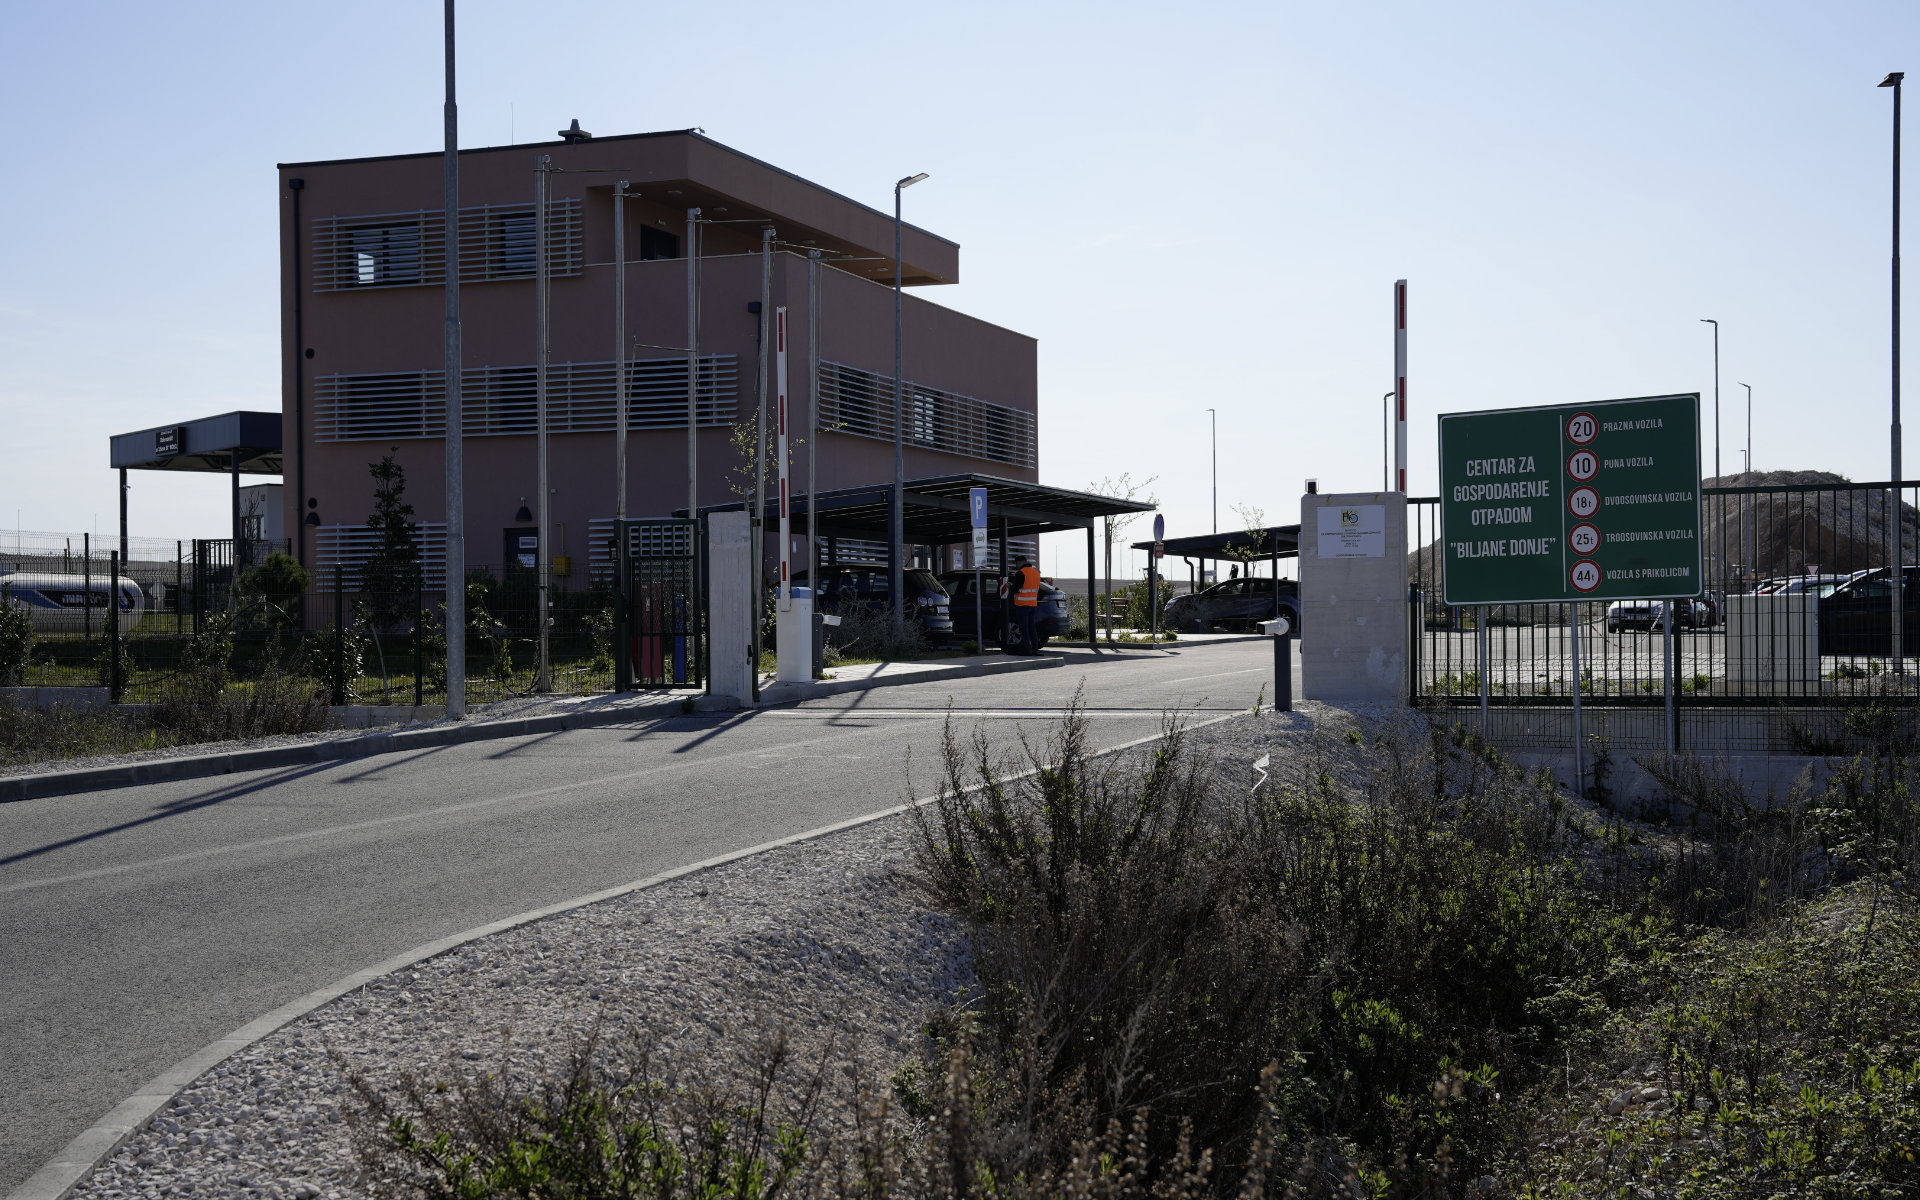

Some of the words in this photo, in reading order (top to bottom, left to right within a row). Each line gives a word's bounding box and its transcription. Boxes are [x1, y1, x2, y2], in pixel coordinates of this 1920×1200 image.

[1573, 420, 1592, 438] 20
[1603, 420, 1634, 432] PRAZNA
[1635, 418, 1663, 430] VOZILA
[1466, 457, 1516, 477] CENTAR
[1518, 455, 1536, 473] ZA
[1575, 457, 1591, 474] 10
[1604, 458, 1625, 469] PUNA
[1626, 456, 1654, 467] VOZILA
[1453, 480, 1550, 502] GOSPODARENJE
[1576, 496, 1592, 509] 18t
[1604, 493, 1664, 506] DVOOSOVINSKA
[1665, 491, 1693, 503] VOZILA
[975, 495, 983, 520] P
[1471, 505, 1532, 526] OTPADOM
[1576, 533, 1594, 545] 25t
[1605, 531, 1664, 543] TROOSOVINSKA
[1665, 529, 1694, 540] VOZILA
[1576, 570, 1595, 582] 44t
[1606, 569, 1634, 580] VOZILA
[1635, 568, 1641, 578] S
[1642, 567, 1690, 577] PRIKOLICOM
